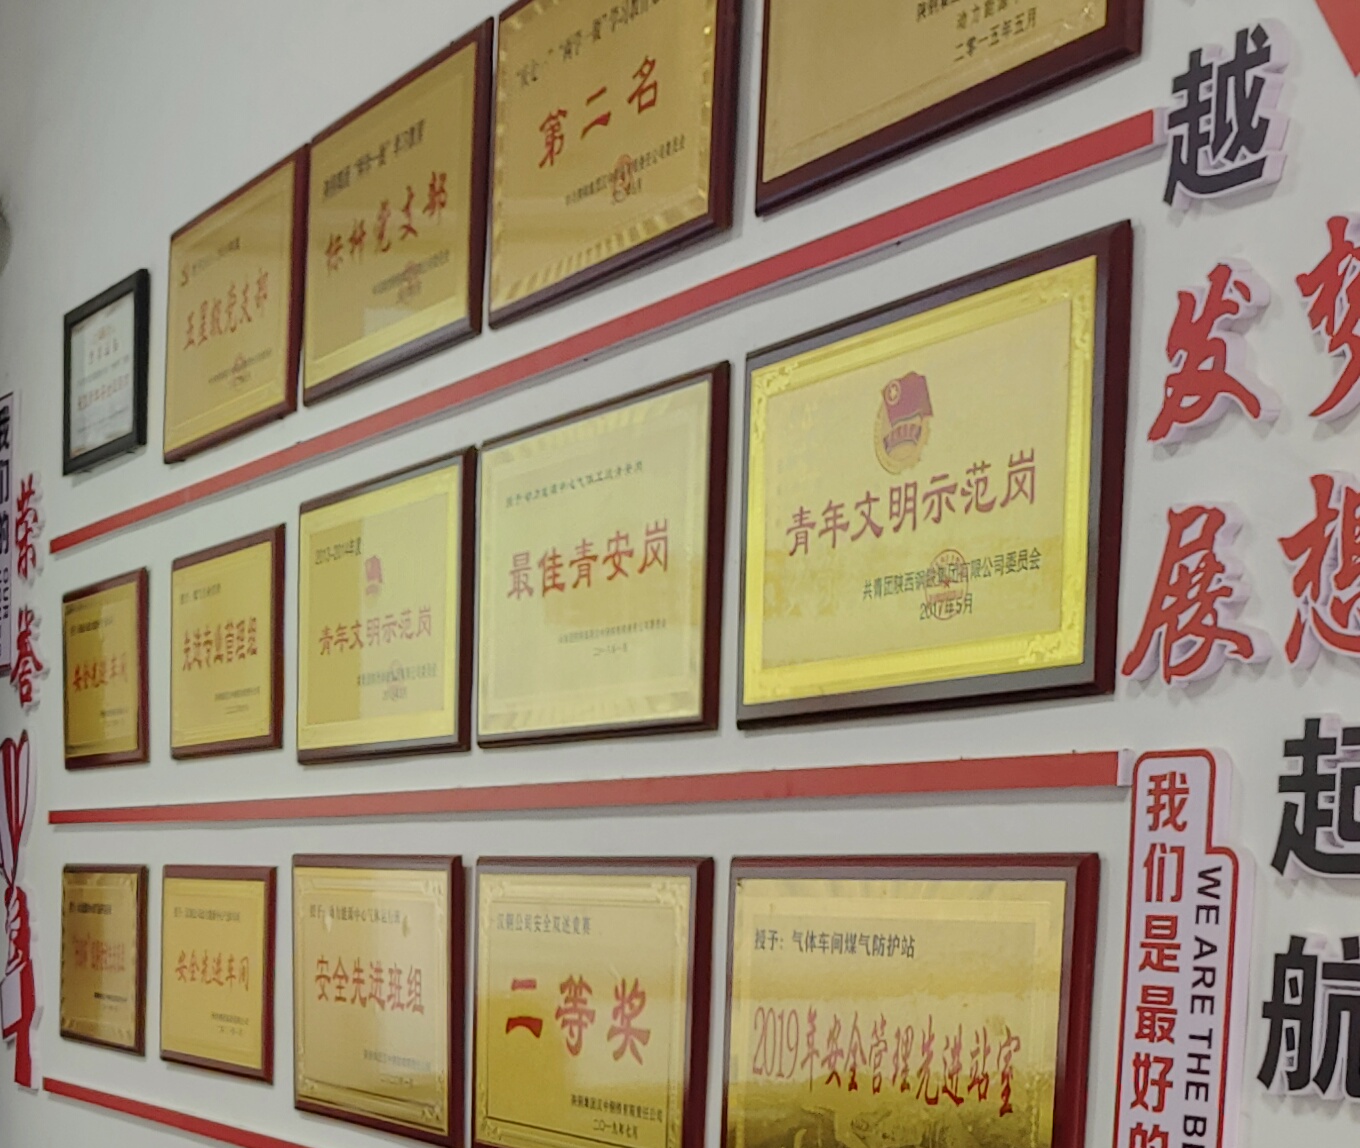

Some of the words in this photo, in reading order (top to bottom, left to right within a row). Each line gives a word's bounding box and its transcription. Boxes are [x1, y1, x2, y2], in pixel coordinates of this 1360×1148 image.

[537, 57, 659, 169] 第二名
[786, 447, 1036, 557] 青年文明示范岗
[10, 473, 43, 707] 荣誉
[507, 518, 668, 600] 最佳青安岗
[319, 606, 431, 655] 青年文明示范岗
[1195, 865, 1222, 925] WE
[315, 955, 424, 1015] 安全先进班组
[1189, 937, 1217, 1015] ARE
[506, 974, 650, 1066] 二等奖
[753, 1005, 1021, 1117] 2019年安全管理先进站室
[1185, 1029, 1213, 1103] THE
